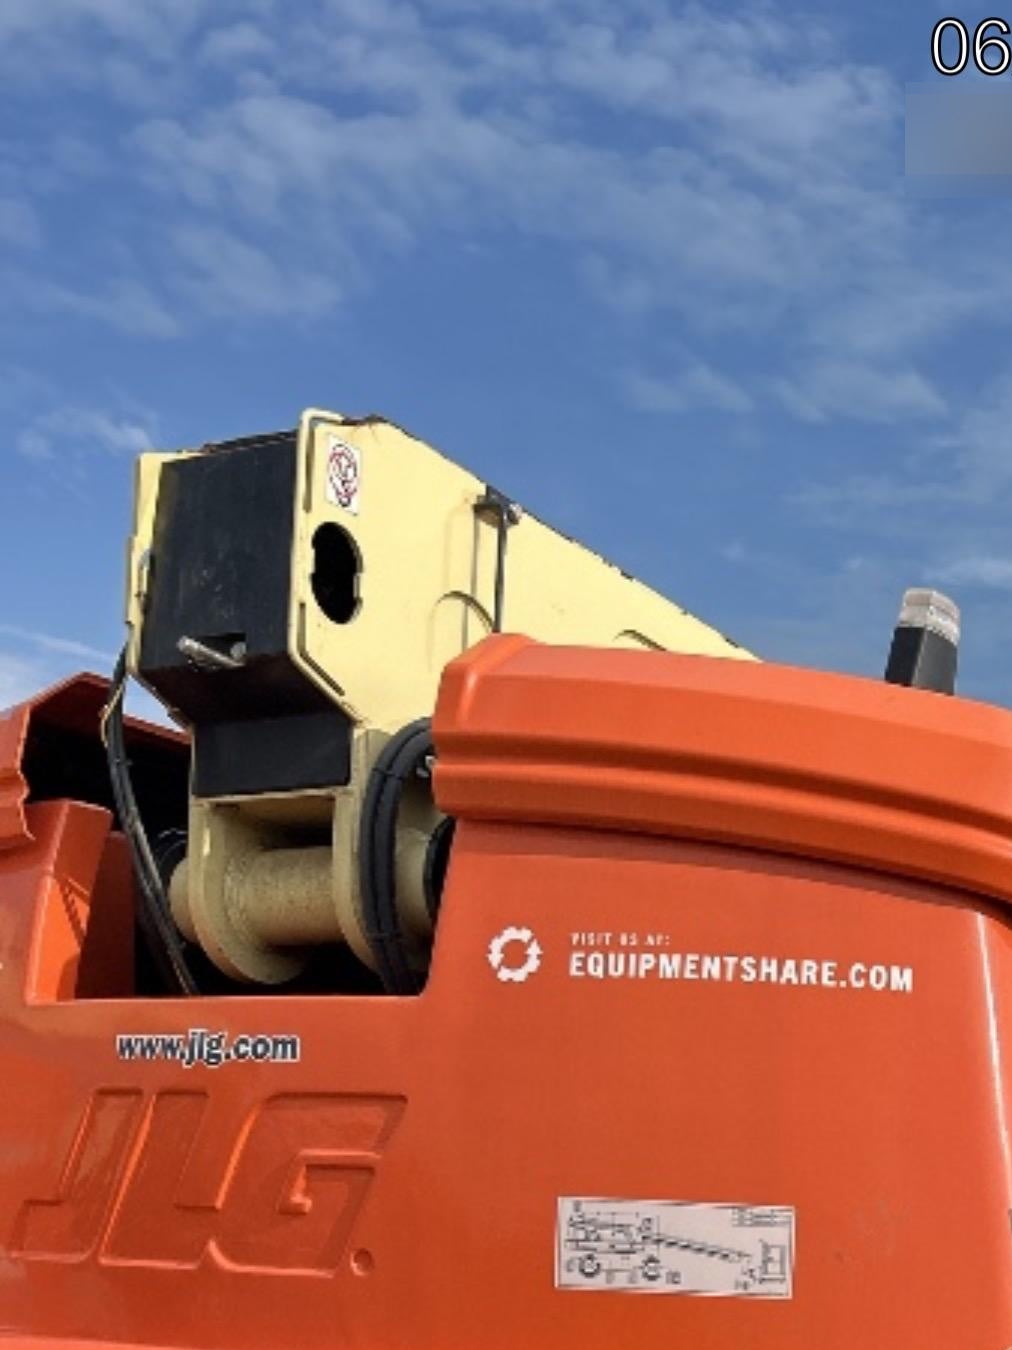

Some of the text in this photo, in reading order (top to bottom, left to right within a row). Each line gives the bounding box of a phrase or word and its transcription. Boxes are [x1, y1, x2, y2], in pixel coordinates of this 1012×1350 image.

[571, 932, 612, 946] VISIT
[569, 952, 912, 993] EQUIPMENTSHARE.COM
[116, 1028, 301, 1069] www.jlg.com
[7, 1086, 409, 1278] JLG
